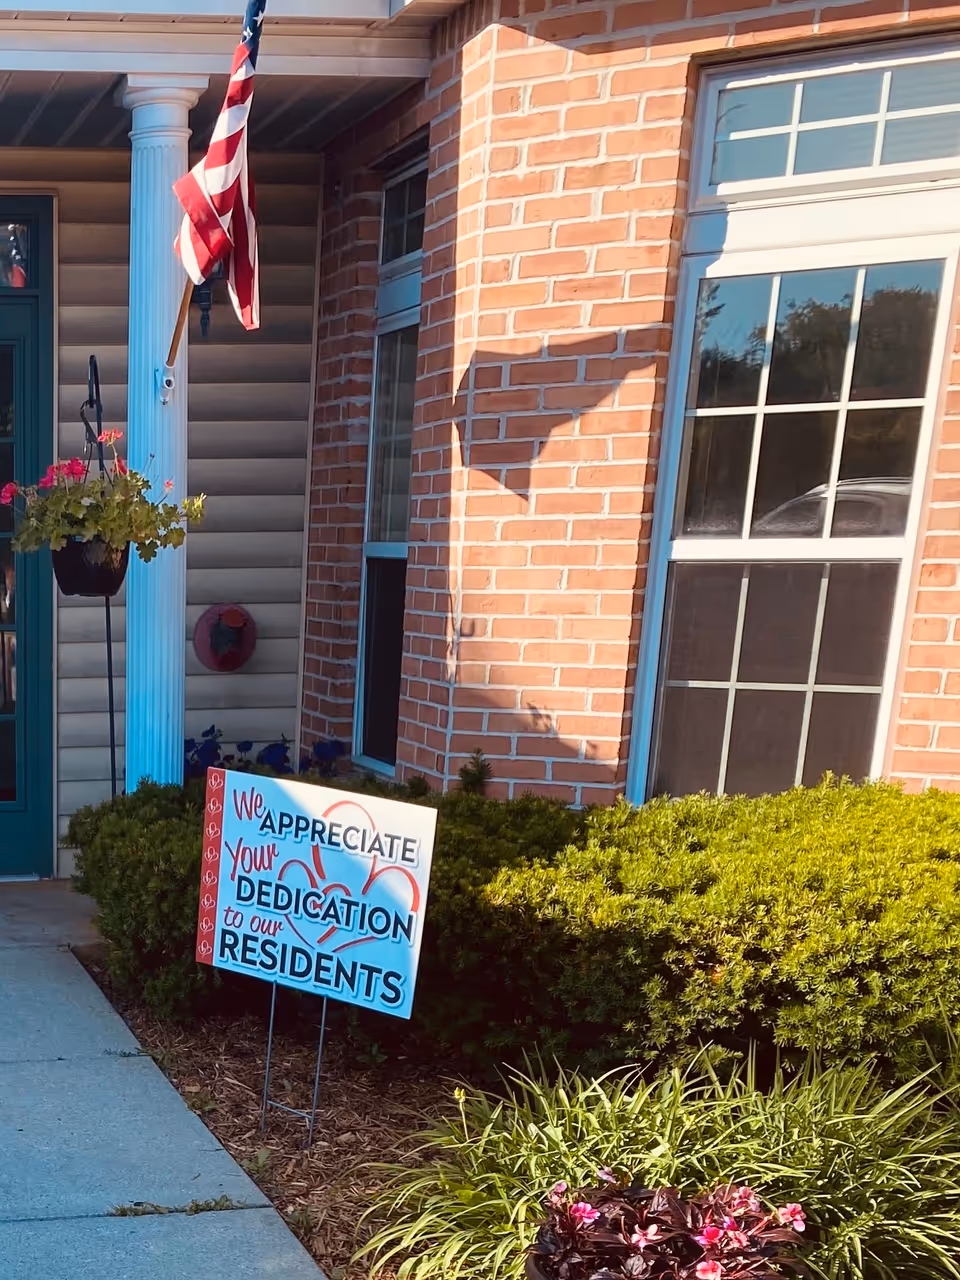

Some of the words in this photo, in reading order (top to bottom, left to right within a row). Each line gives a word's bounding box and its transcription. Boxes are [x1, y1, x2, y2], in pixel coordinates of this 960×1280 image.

[233, 787, 265, 821] We
[224, 837, 279, 882] Your
[259, 809, 417, 863] APPRECIATE
[223, 905, 244, 928] to
[249, 915, 285, 938] our
[236, 875, 414, 942] DEDICATION
[218, 928, 402, 1004] RESIDENTS
